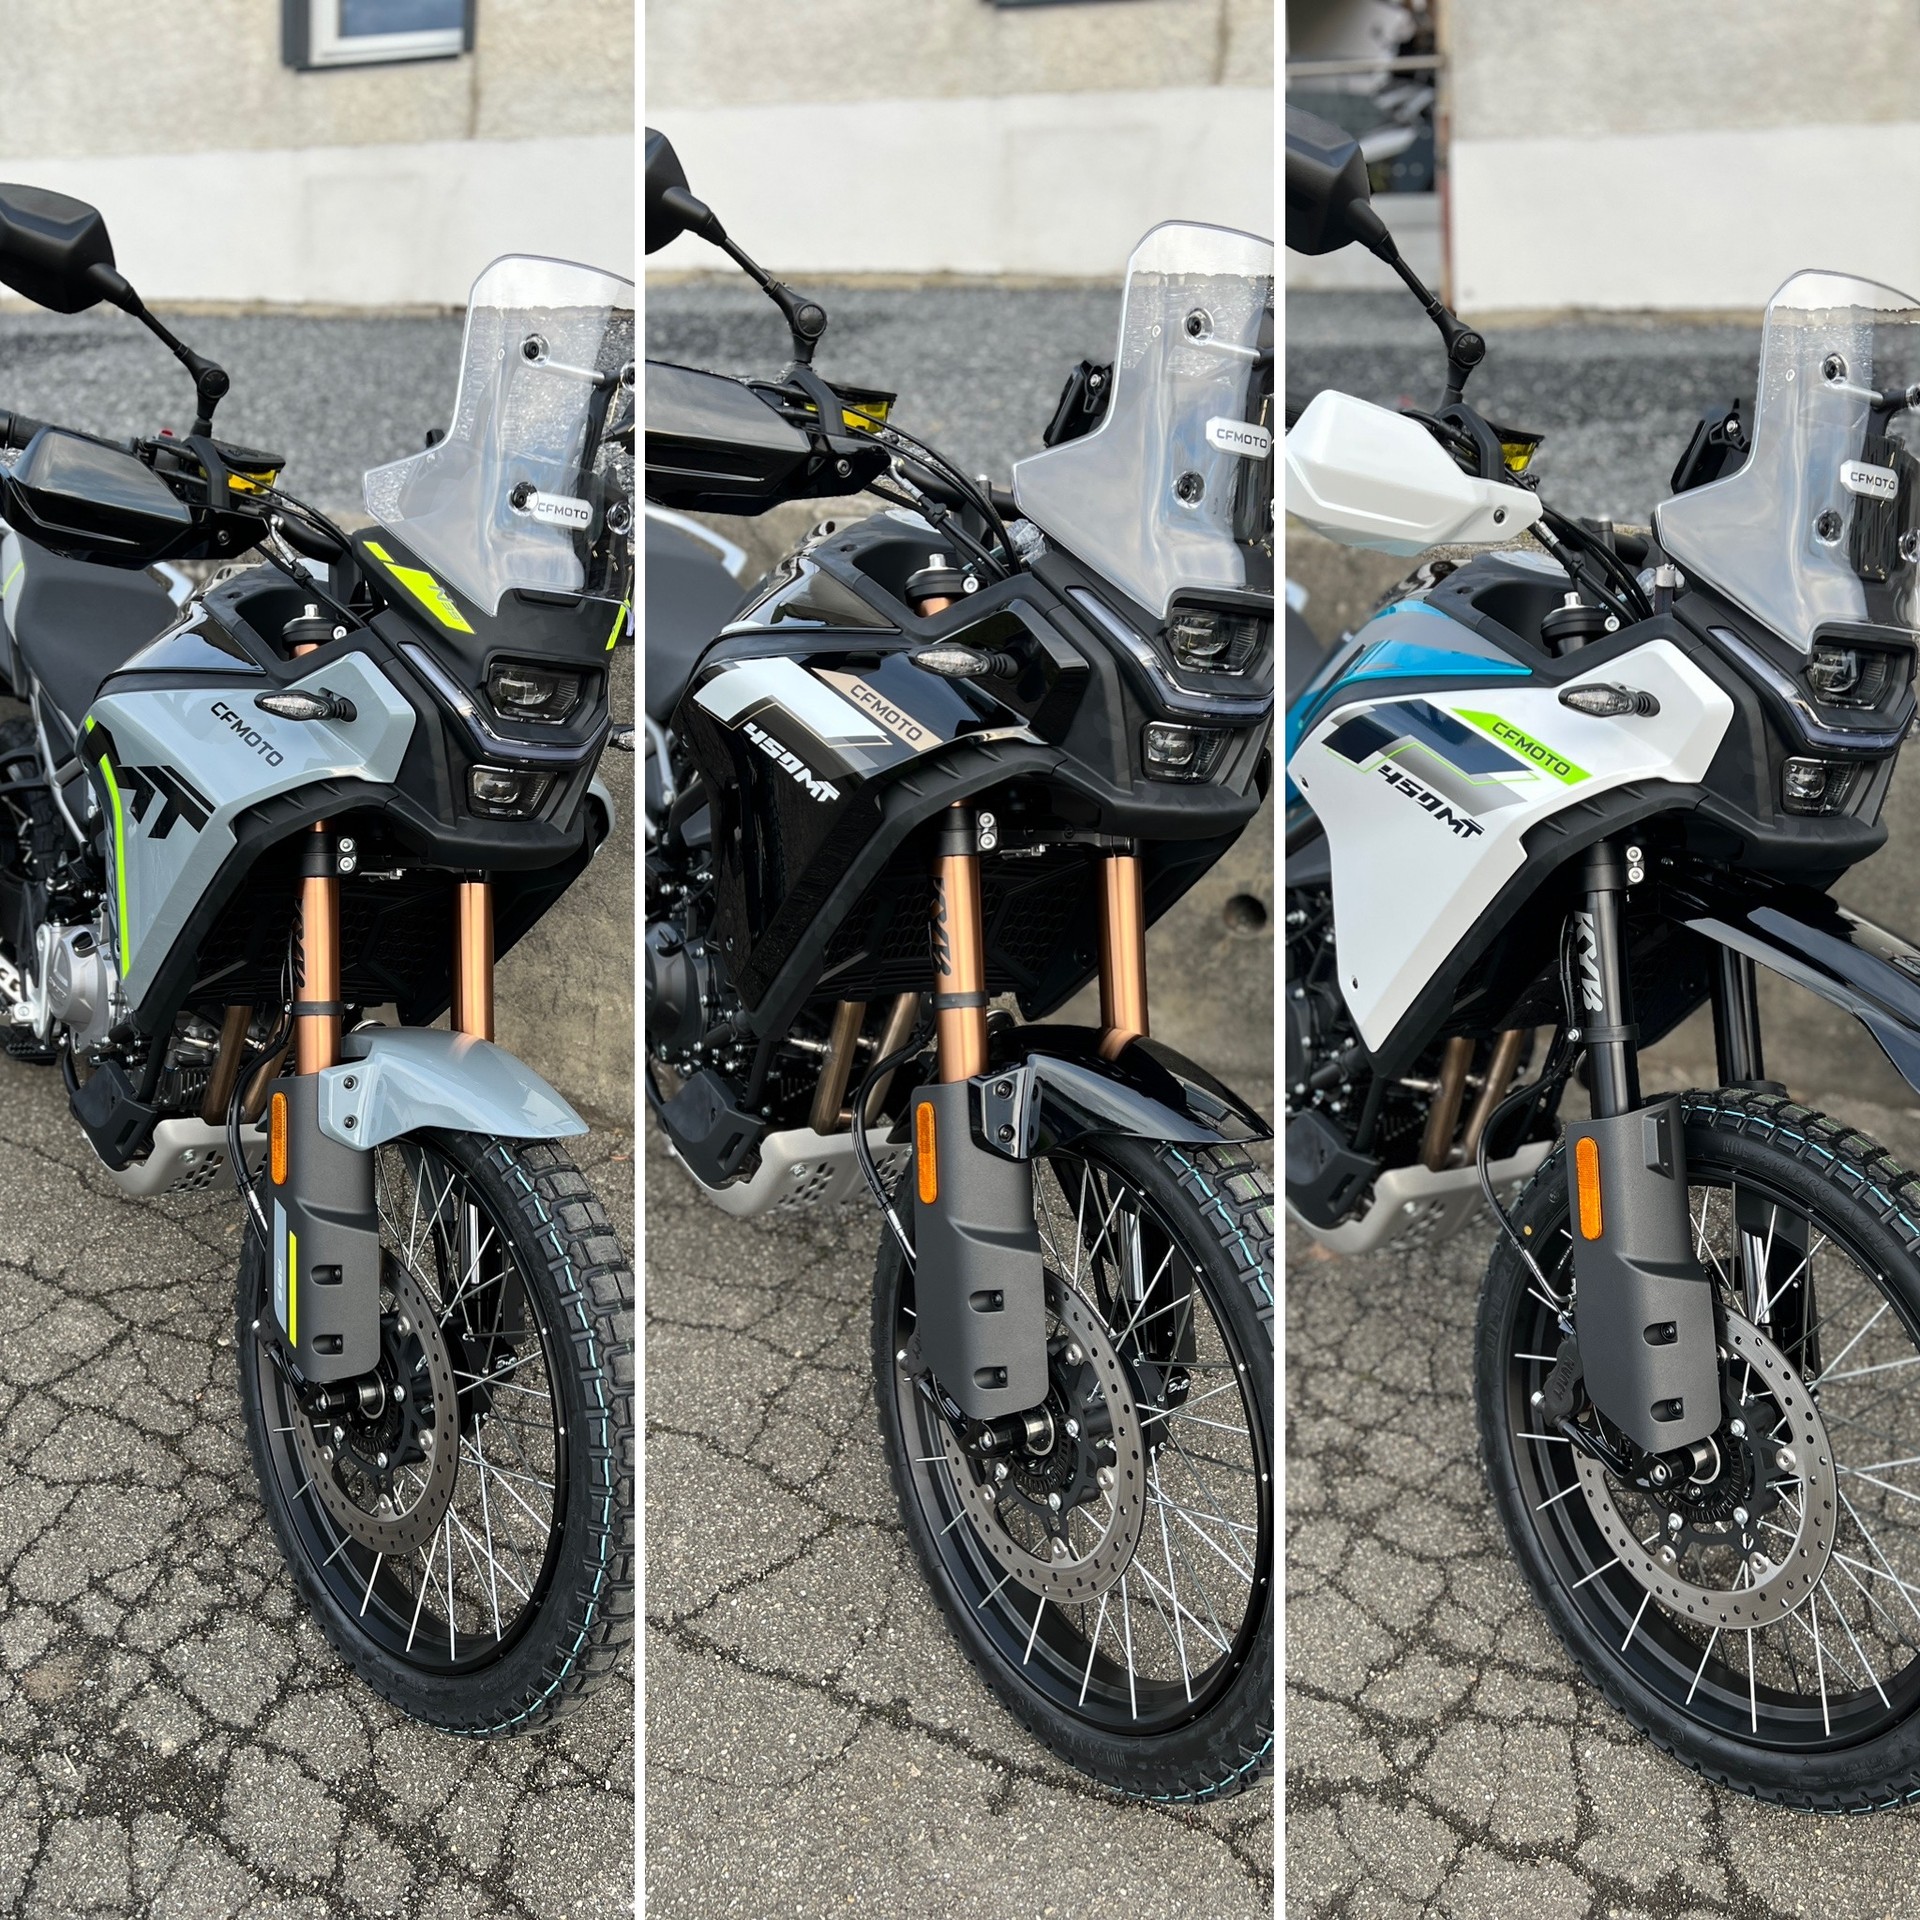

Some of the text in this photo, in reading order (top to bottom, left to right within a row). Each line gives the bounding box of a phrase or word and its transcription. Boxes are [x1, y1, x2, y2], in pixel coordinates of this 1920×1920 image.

[1216, 428, 1268, 449] CFMOTO
[1850, 471, 1896, 490] CFMOTO
[537, 502, 589, 520] CFMOTO
[210, 701, 284, 767] CFMOTO
[850, 684, 923, 742] CFMOTO
[742, 721, 841, 802] 450MT
[1491, 722, 1571, 777] CFMOTO
[1377, 764, 1486, 839] 450MT
[1574, 910, 1604, 1012] KYB
